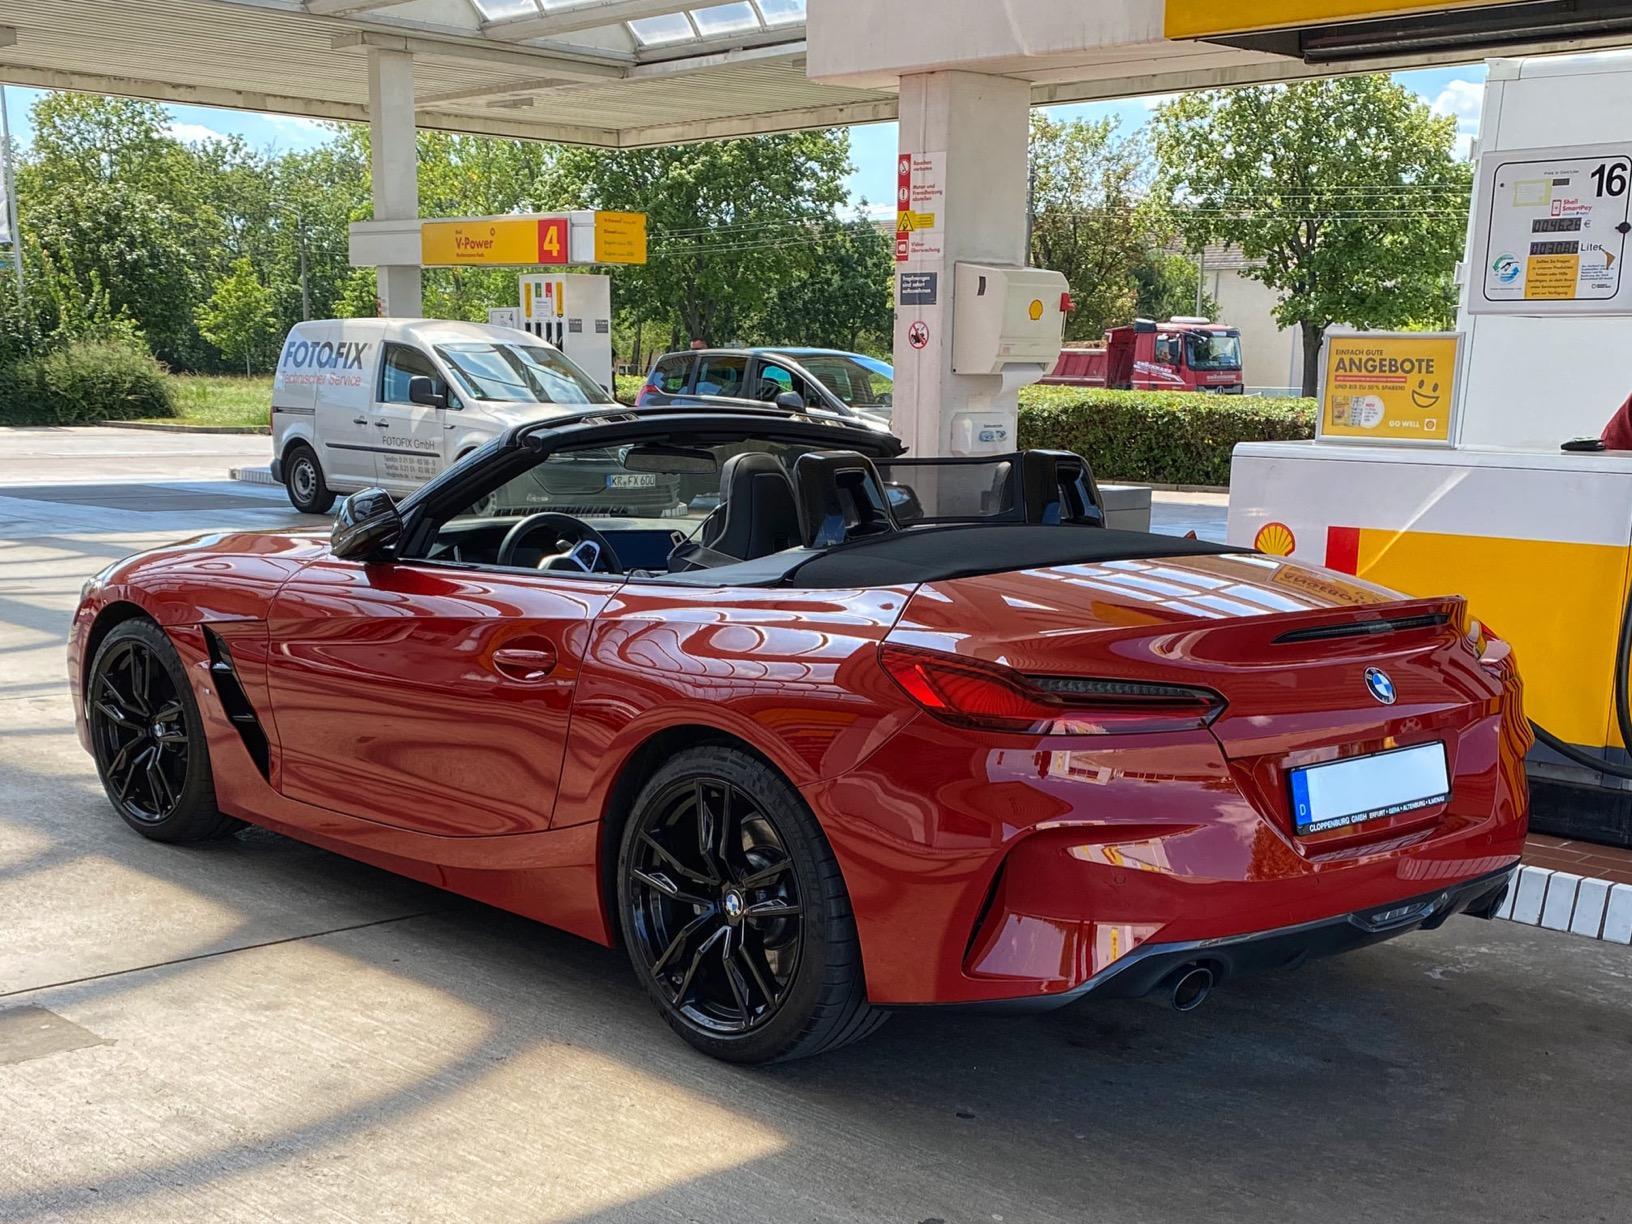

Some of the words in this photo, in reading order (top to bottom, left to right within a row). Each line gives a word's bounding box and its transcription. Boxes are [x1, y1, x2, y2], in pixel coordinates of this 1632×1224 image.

[1590, 162, 1628, 198] 16
[1583, 219, 1592, 229] €
[543, 225, 561, 257] 4
[1581, 242, 1603, 252] Liter
[283, 341, 368, 369] FOTOFIX
[1334, 357, 1434, 374] ANGEBOTE
[1388, 420, 1400, 428] GO
[1401, 420, 1421, 428] WELL
[382, 435, 413, 448] FOTOFIX
[413, 439, 435, 450] GmbH
[627, 475, 639, 486] FX
[1299, 803, 1307, 816] D
